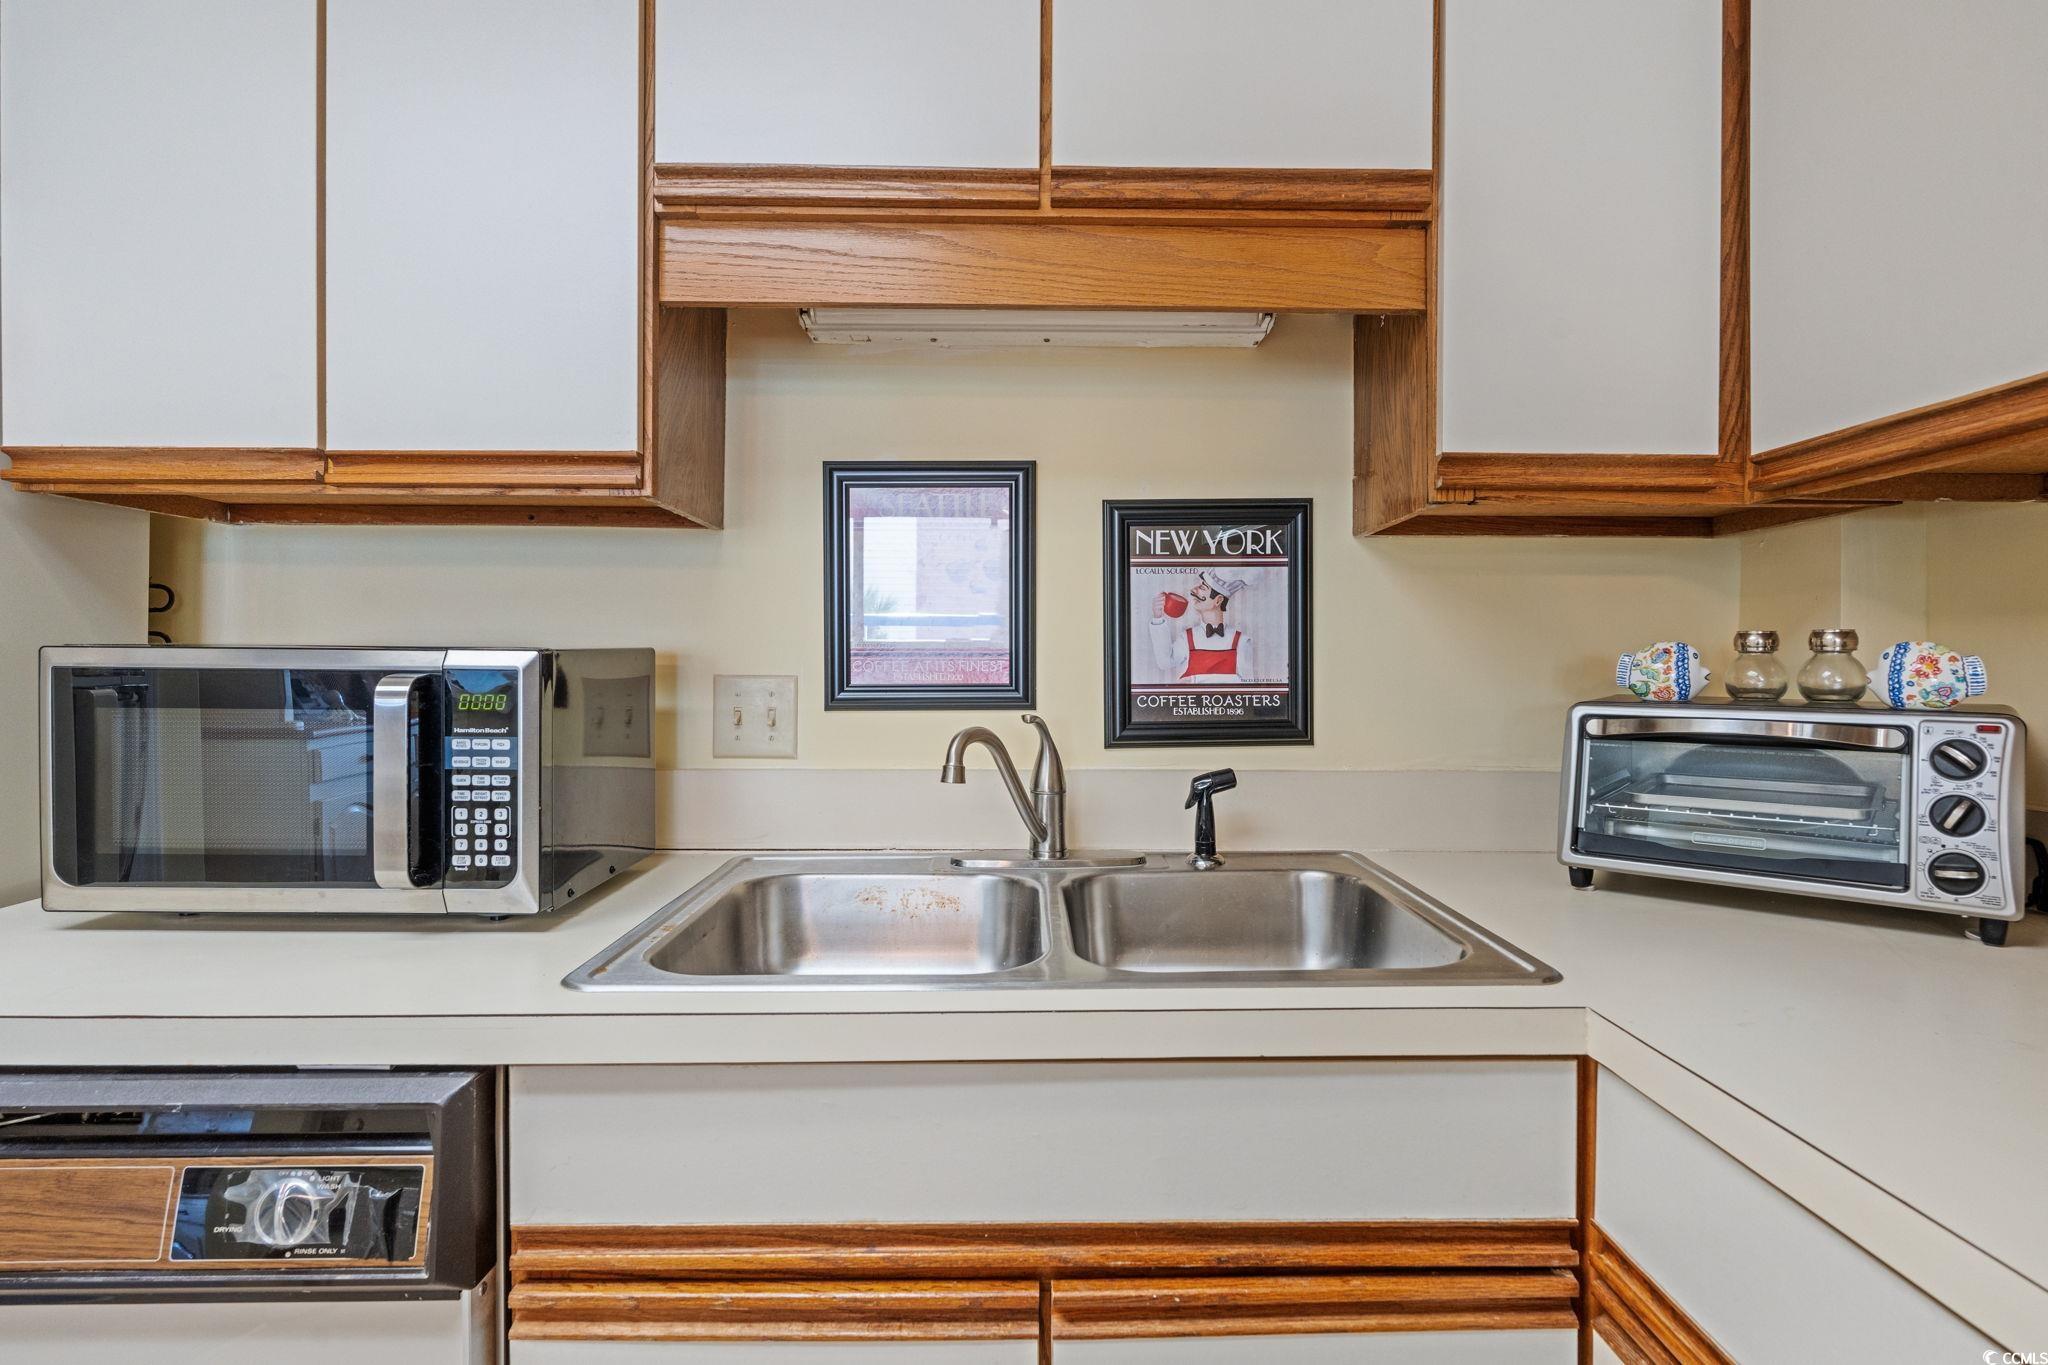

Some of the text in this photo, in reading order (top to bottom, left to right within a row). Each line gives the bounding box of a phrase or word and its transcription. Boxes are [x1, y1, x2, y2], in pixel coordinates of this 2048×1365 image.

[1136, 529, 1283, 555] NEW YORK
[959, 660, 1005, 673] FINEST
[1136, 694, 1281, 708] COFFEE ROASTERS
[1173, 707, 1226, 716] ESTABLISHED
[318, 1247, 338, 1255] ONLY
